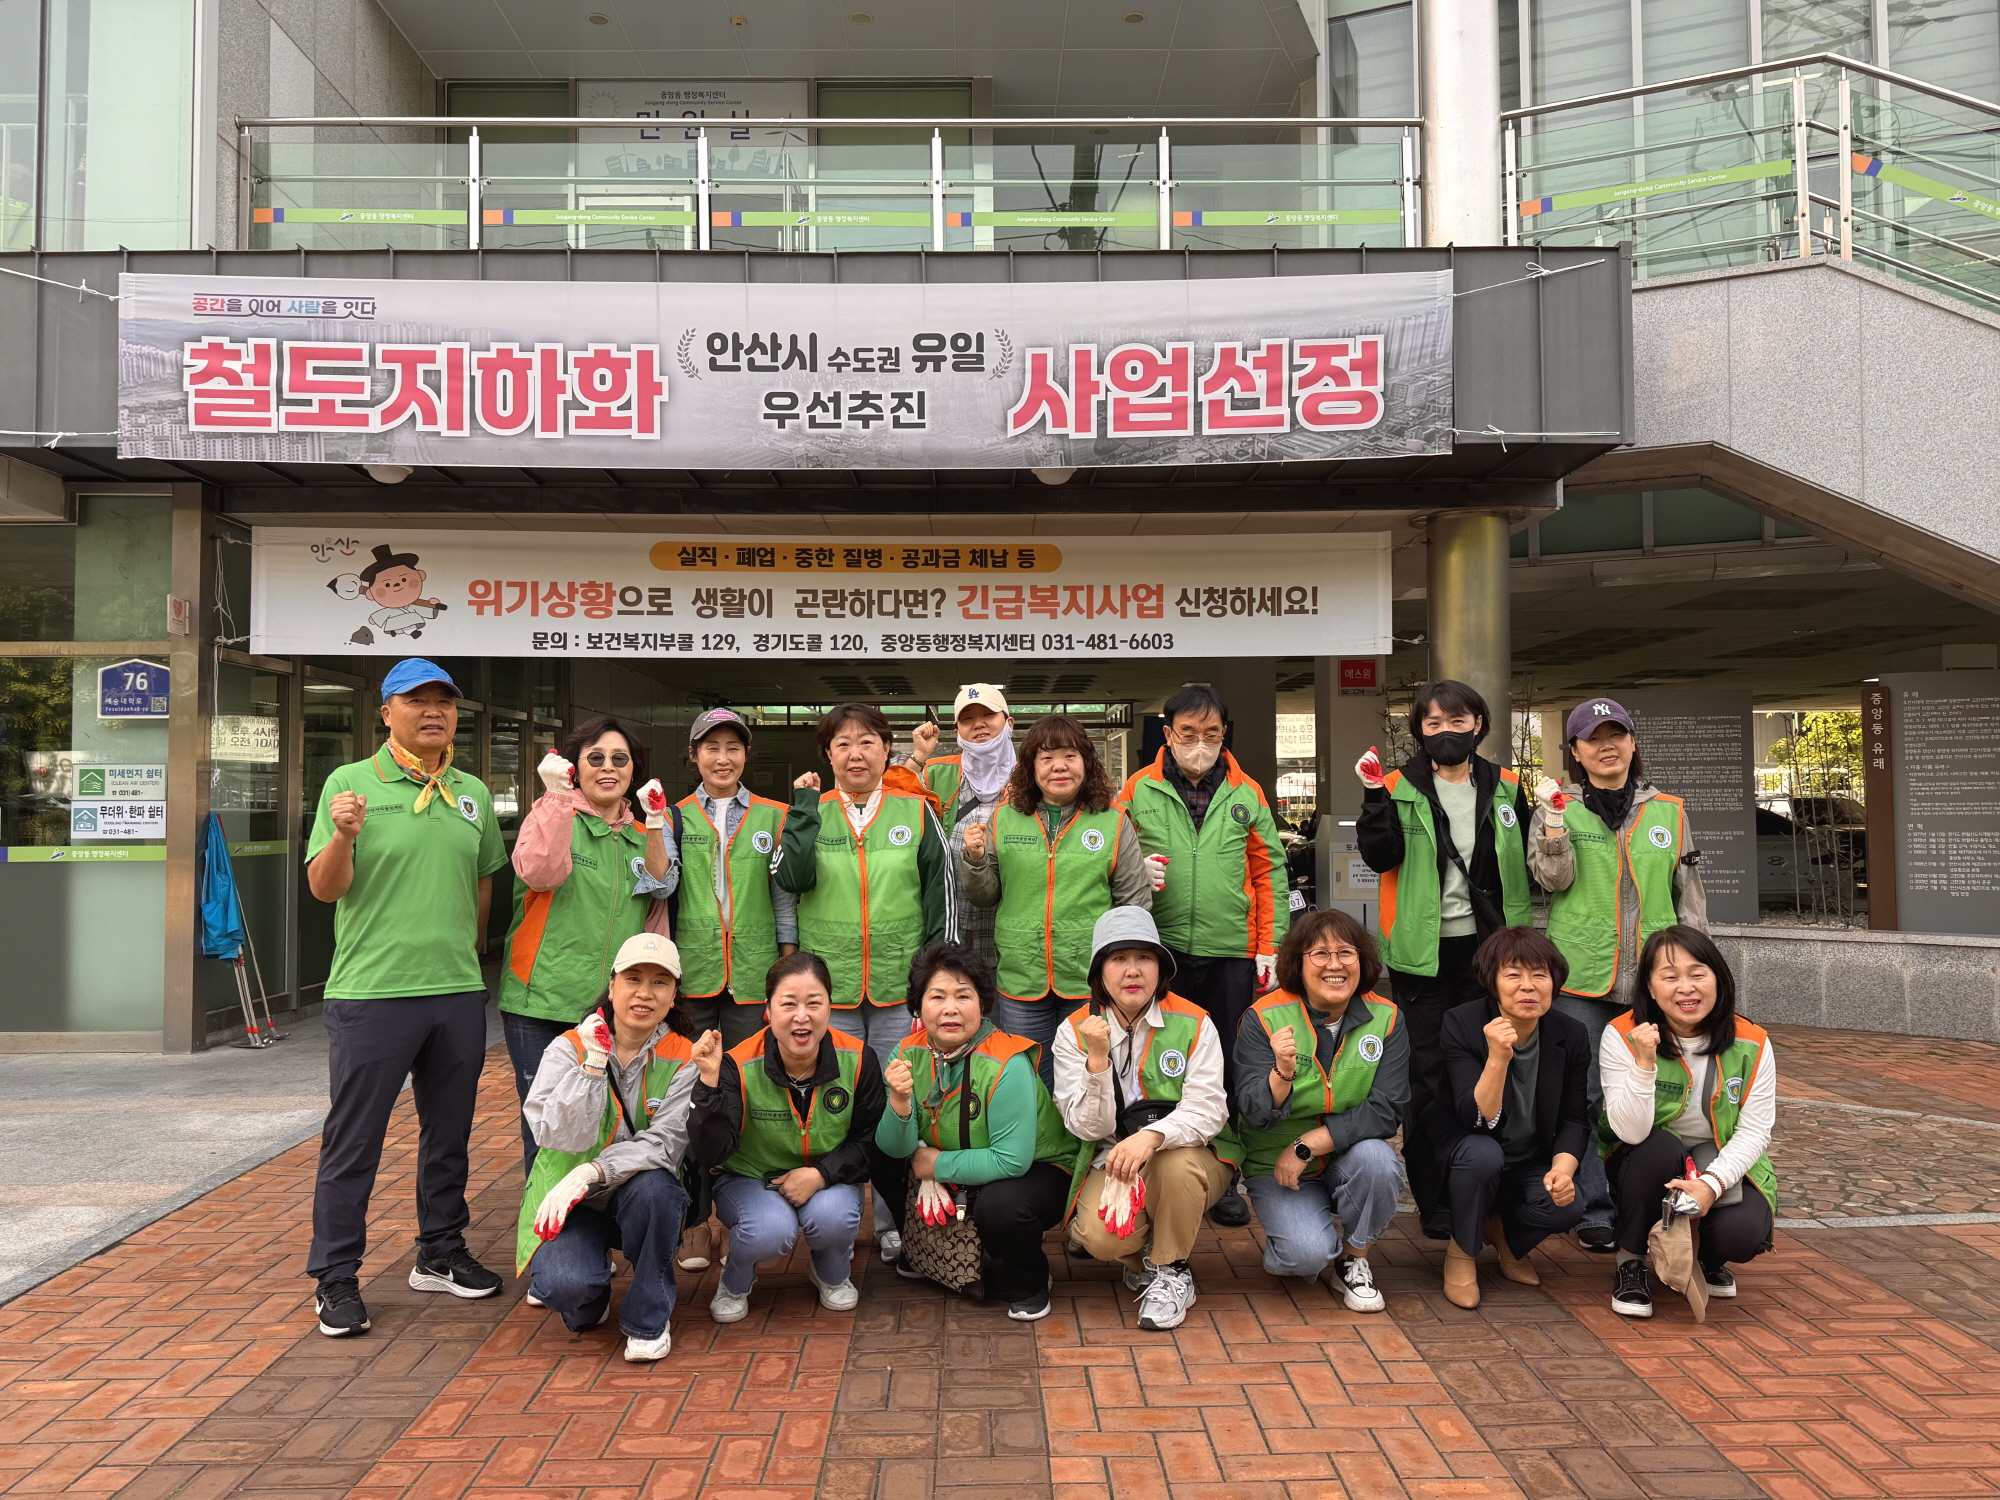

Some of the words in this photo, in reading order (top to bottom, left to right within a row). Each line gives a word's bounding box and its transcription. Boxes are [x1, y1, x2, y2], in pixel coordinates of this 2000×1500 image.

[684, 91, 726, 99] 행정복지센터
[1613, 185, 1653, 197] Jungang-dong
[1654, 180, 1686, 190] Community
[1687, 177, 1706, 185] Service
[1973, 200, 1994, 212] 중앙동
[1285, 214, 1302, 222] 중앙동
[192, 298, 242, 312] 공간을
[287, 300, 337, 314] 사람을
[344, 301, 377, 317] 잇다
[706, 331, 818, 373] 안산시
[827, 347, 900, 373] 수도권
[911, 331, 985, 373] 유일
[184, 337, 668, 438] 철도지하화
[1008, 335, 1384, 438] 사업선정
[763, 390, 927, 429] 우선추진
[677, 546, 718, 567] 실직
[736, 546, 776, 568] 폐업
[794, 547, 835, 568] 중한
[842, 547, 883, 568] 질병
[901, 548, 962, 568] 공과금
[968, 548, 1009, 568] 체납
[1016, 548, 1036, 568] 등
[467, 579, 674, 620] 위기상황으로
[691, 586, 774, 619] 생활이
[794, 588, 947, 619] 곤란하다면?
[956, 583, 1164, 620] 긴급복지사업
[1174, 586, 1319, 618] 신청하세요!
[532, 632, 568, 650] 문의
[586, 632, 694, 652] 보건복지부콜
[701, 633, 740, 653] 129,
[753, 634, 823, 652] 경기도콜
[829, 634, 868, 654] 120,
[880, 634, 1036, 652] 중앙동행정복지센터
[1041, 633, 1174, 651] 031-481-6603
[124, 672, 148, 691] 76
[1344, 668, 1371, 680] 에스원
[968, 688, 980, 700] LA
[1592, 703, 1612, 716] NY
[1870, 692, 1884, 735] 중앙동
[230, 726, 250, 736] 오후
[230, 736, 250, 747] 오전
[1872, 742, 1884, 770] 유래
[109, 768, 142, 779] 미세먼지
[146, 768, 162, 779] 쉼터
[148, 806, 164, 819] 쉼터
[72, 850, 90, 859] 중앙동
[92, 850, 128, 858] 행정복지센터
